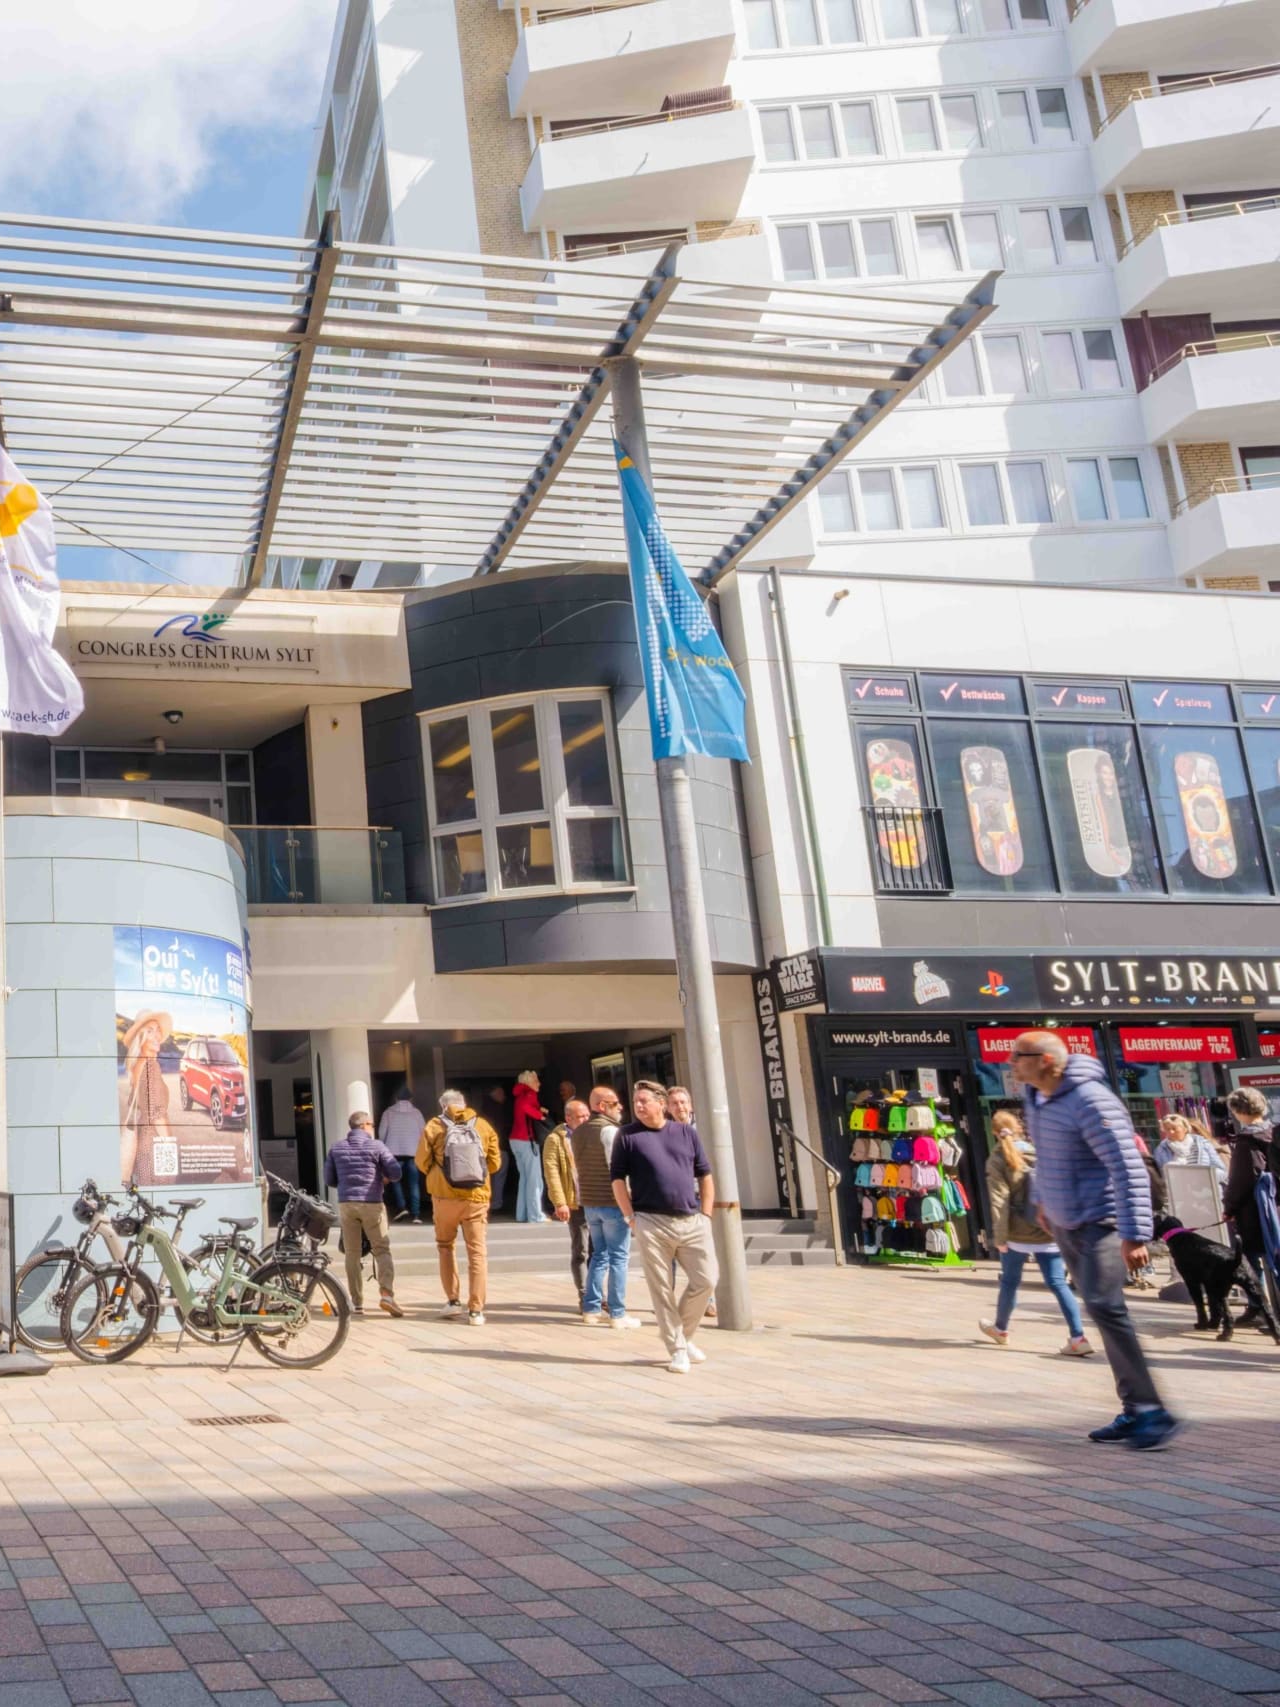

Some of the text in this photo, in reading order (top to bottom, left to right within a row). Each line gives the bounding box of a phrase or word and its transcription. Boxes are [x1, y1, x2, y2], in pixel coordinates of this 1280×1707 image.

[77, 640, 315, 663] CONGRESS CENTRUM SYLT
[168, 660, 231, 671] WESTERLAND
[874, 686, 905, 697] Schuhe
[960, 689, 1007, 701] Bettwäsche
[1076, 693, 1106, 705] Kappen
[1174, 697, 1213, 710] Spielzeug
[143, 944, 178, 969] Oui
[778, 955, 813, 978] STAR
[144, 970, 177, 989] are
[777, 970, 815, 994] WARS
[851, 976, 885, 992] MARVEL
[832, 1030, 951, 1047] www.sylt-brands.de
[1124, 1038, 1204, 1051] LAGERVERKAUF
[1069, 1043, 1092, 1055] 70%
[1209, 1043, 1232, 1054] 70%
